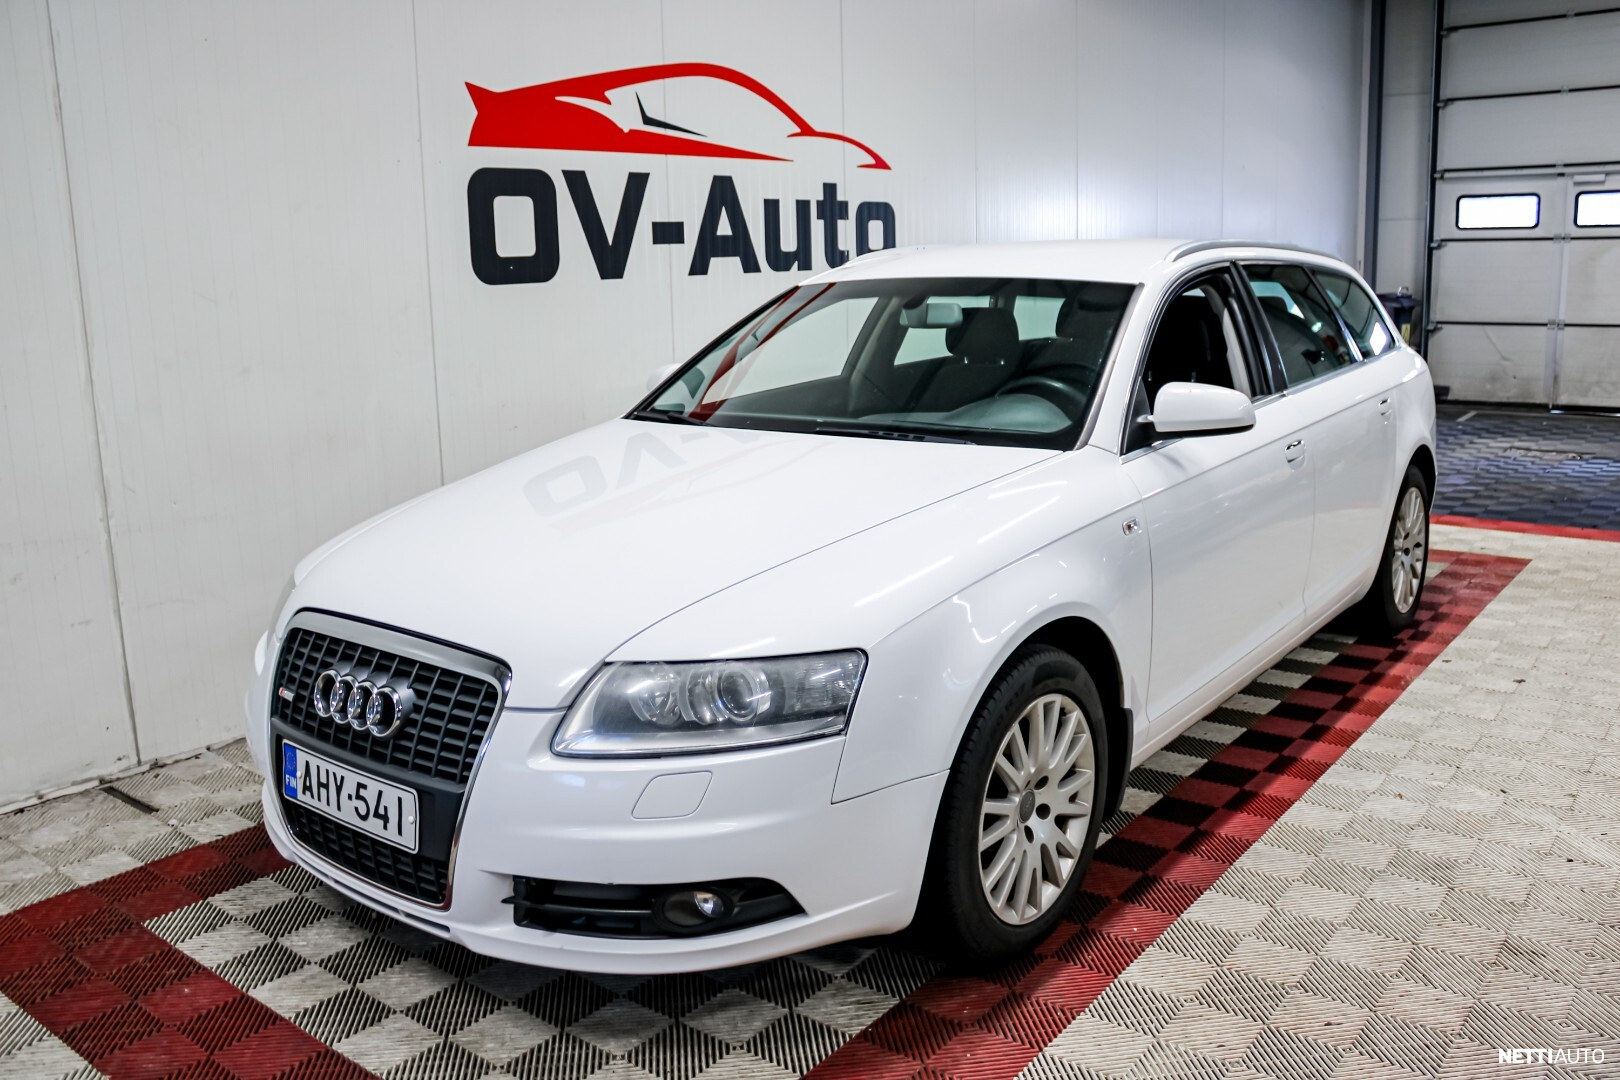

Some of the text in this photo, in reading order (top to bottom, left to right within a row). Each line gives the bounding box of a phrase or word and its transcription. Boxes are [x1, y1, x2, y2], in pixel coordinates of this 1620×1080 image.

[467, 167, 896, 285] OV-Auto
[285, 774, 297, 789] FIN
[302, 760, 403, 837] AHY-541
